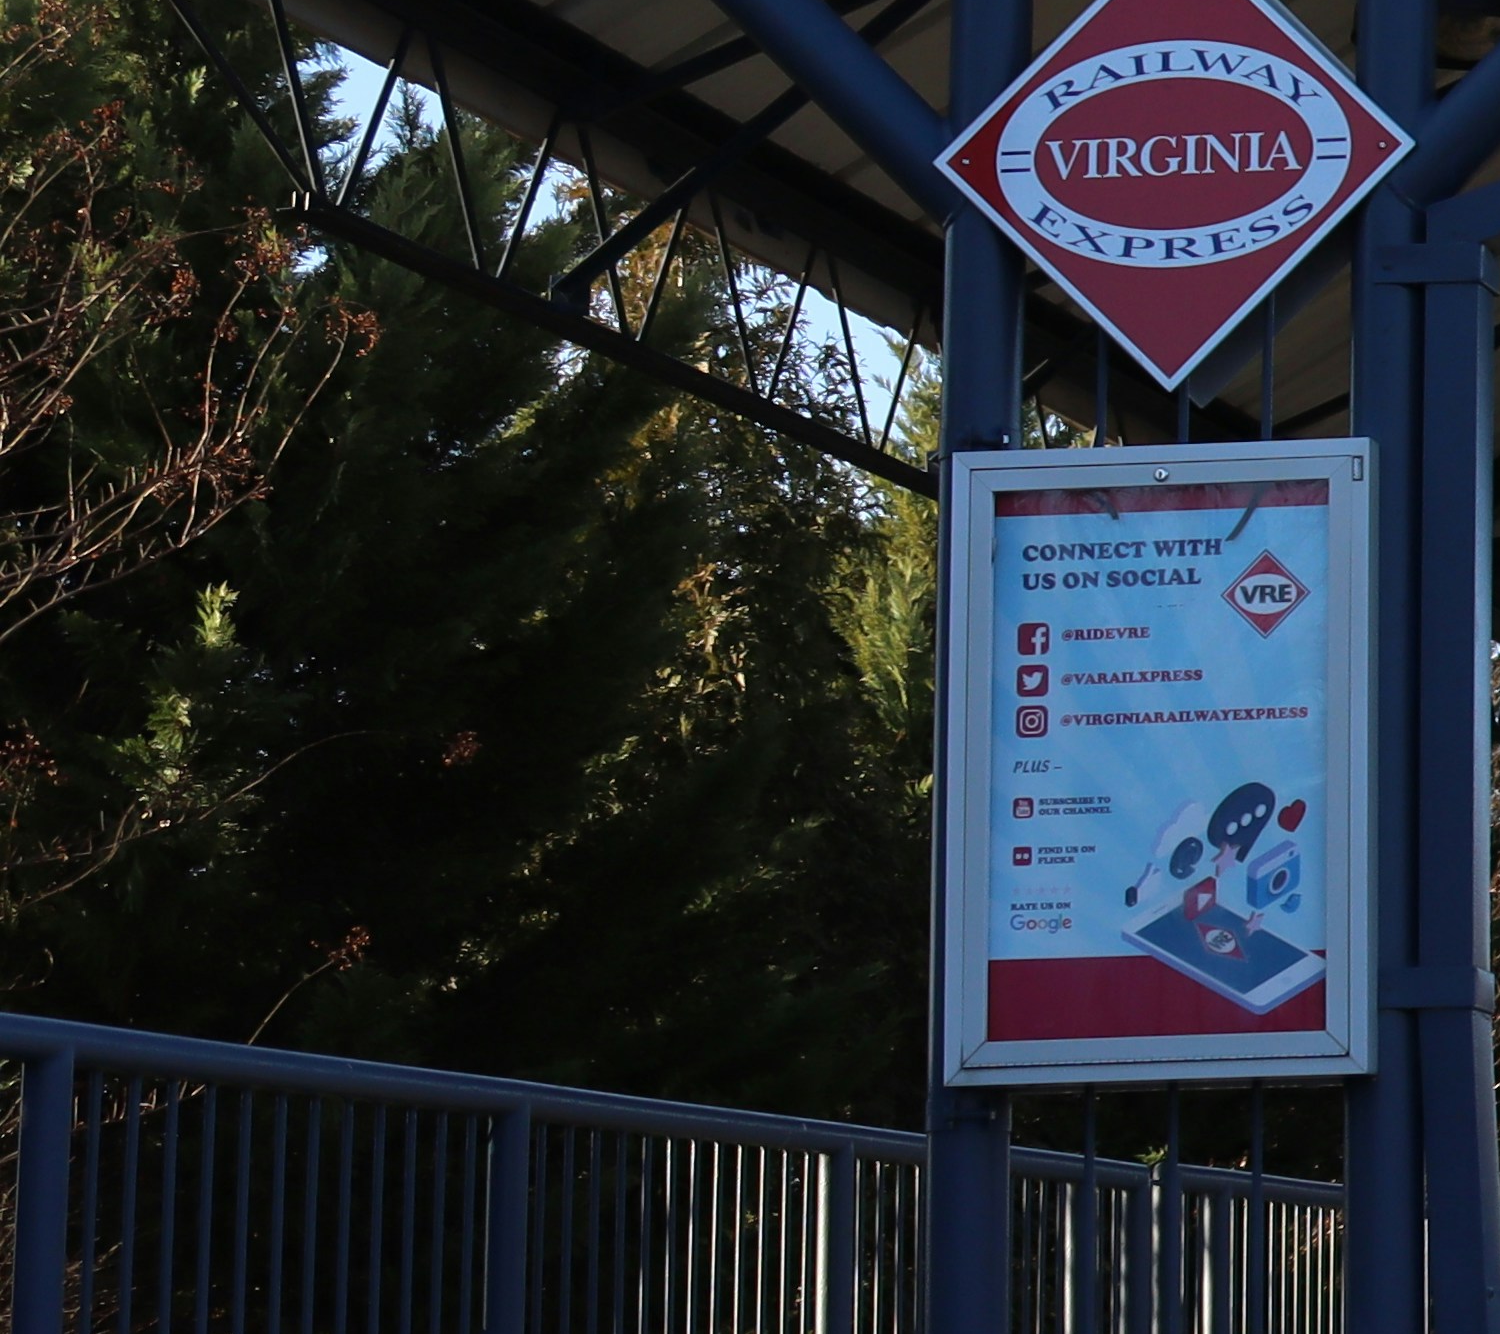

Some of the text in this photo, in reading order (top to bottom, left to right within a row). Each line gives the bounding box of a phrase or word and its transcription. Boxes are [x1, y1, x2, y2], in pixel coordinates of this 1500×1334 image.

[1039, 48, 1322, 114] RAILWAY
[1044, 130, 1304, 181] VIRGINIA
[1030, 194, 1315, 261] EXPRESS
[1021, 538, 1223, 563] CONNECT WITH
[1021, 567, 1202, 591] US ON SOCIAL
[1239, 583, 1294, 605] VRE
[1061, 625, 1151, 642] @RIDEVRE
[1060, 668, 1204, 686] @VARAILXPRESS
[1059, 706, 1309, 727] @VIRGINIARAILWAYEXPRESS
[1012, 759, 1051, 774] PLUS
[1038, 796, 1111, 806] SUBSCRIBE TO
[1038, 806, 1113, 816] OUR CHANNEL
[1037, 845, 1096, 855] FIND US ON
[1037, 856, 1076, 865] FLICKR
[1010, 901, 1072, 911] RATE US ON
[1009, 913, 1072, 935] Google
